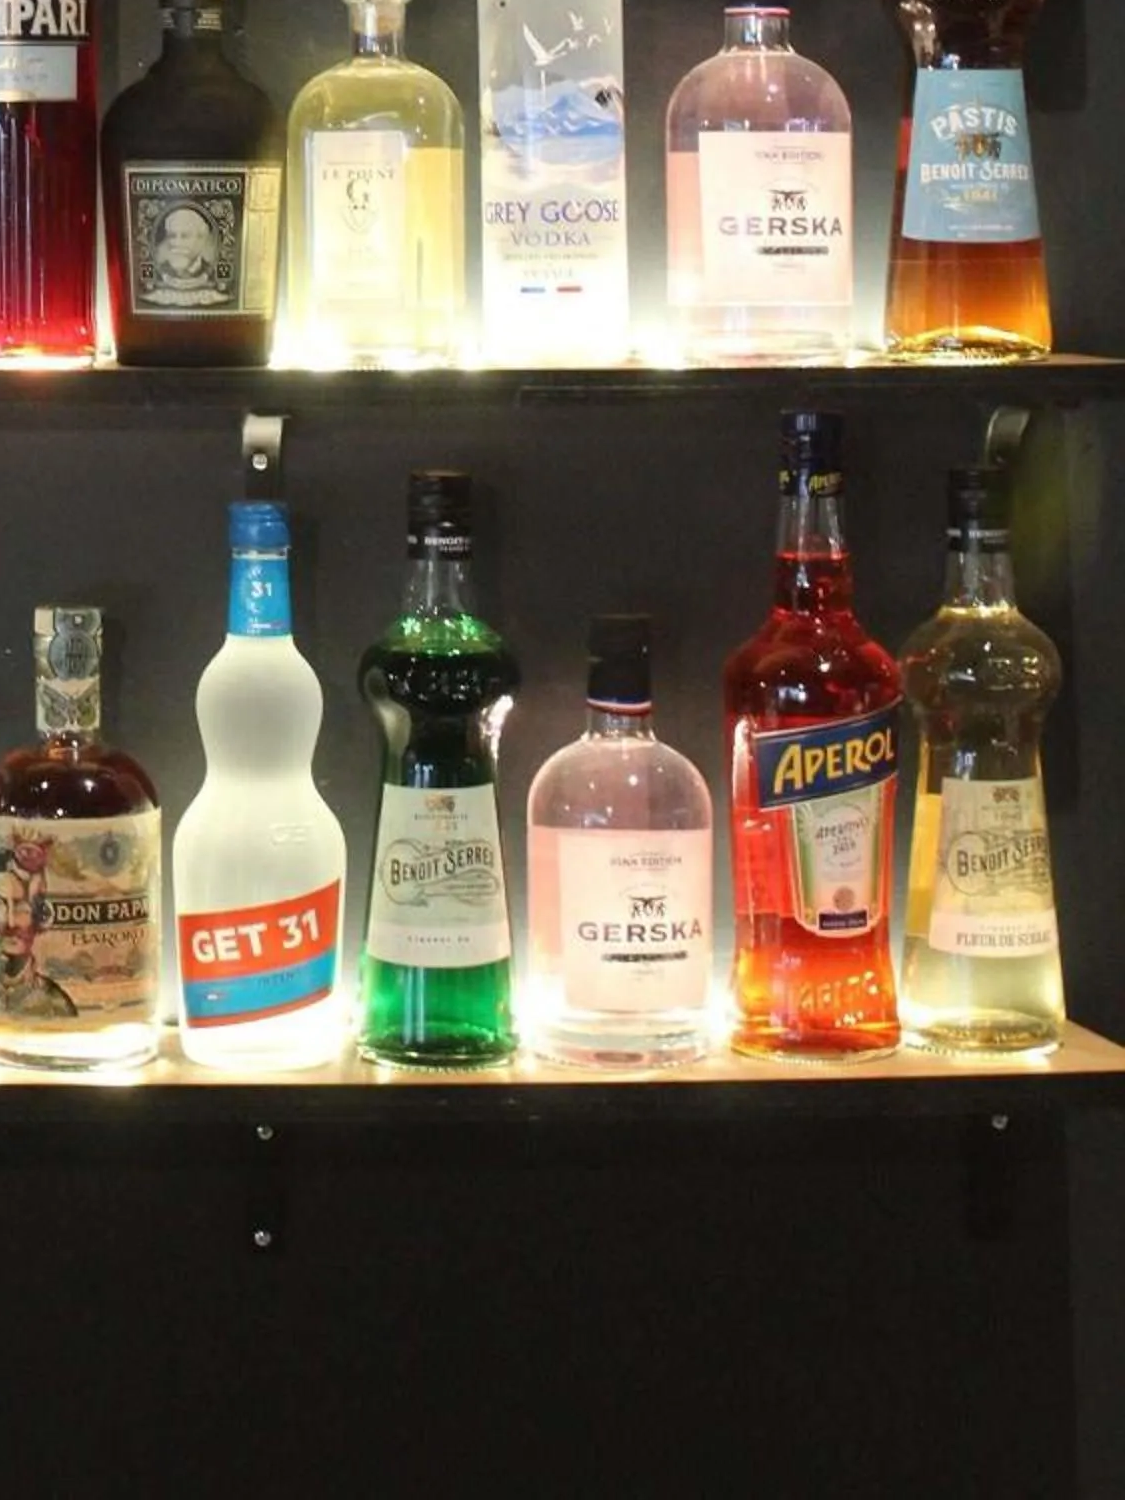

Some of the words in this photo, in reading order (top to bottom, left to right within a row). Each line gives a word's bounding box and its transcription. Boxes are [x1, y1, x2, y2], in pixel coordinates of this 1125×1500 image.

[347, 168, 395, 180] POINT
[920, 163, 974, 182] BENOIT
[485, 201, 531, 224] GREY
[540, 200, 619, 223] GOOSE
[511, 230, 590, 247] VODKA
[719, 217, 842, 236] GERSKA
[774, 728, 894, 794] APEROL
[391, 859, 440, 885] BENOIT
[957, 850, 1008, 877] BENOIT
[57, 905, 100, 921] DON
[192, 922, 267, 963] GET
[279, 909, 319, 949] 31
[578, 918, 702, 943] GERSKA
